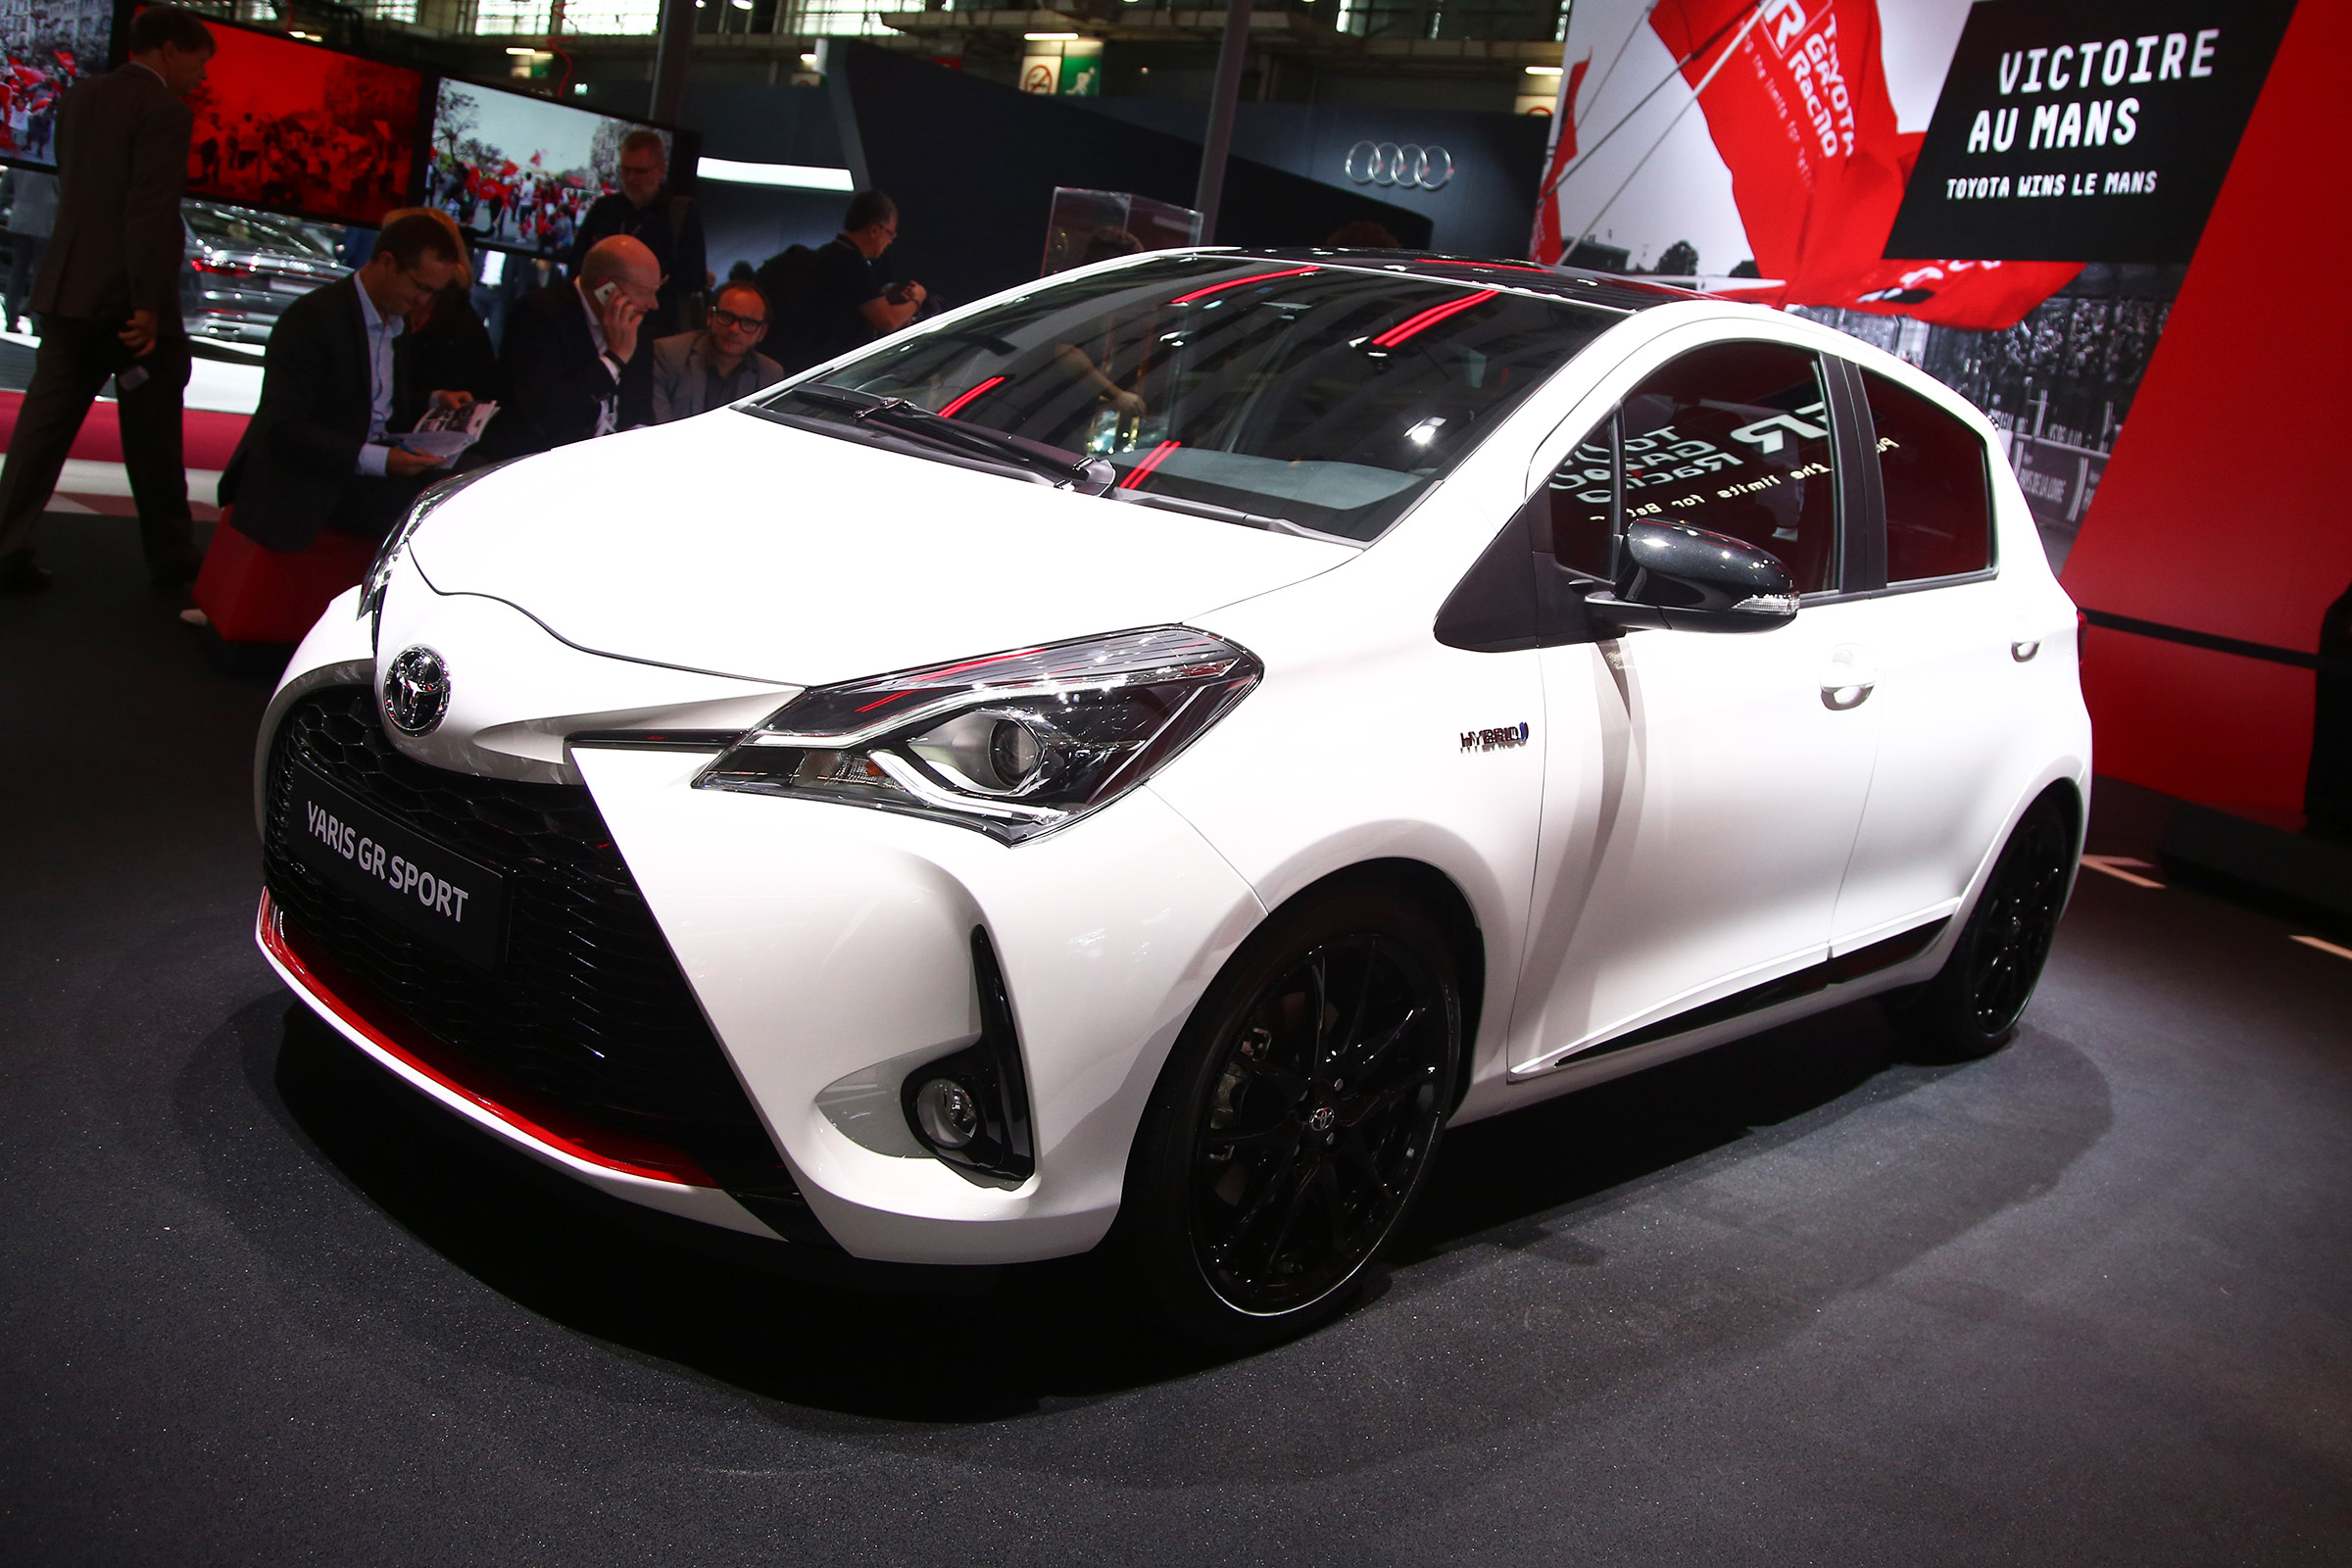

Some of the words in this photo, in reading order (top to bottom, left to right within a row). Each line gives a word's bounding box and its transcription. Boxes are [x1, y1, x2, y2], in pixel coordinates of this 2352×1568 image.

[1998, 28, 2220, 95] VICTOIRE
[1967, 109, 2019, 154] AU
[2029, 97, 2140, 150] MANS
[1946, 176, 2010, 200] TOYOTA
[2017, 173, 2066, 198] WINS
[2071, 172, 2098, 196] LE
[2103, 171, 2158, 195] MANS
[1460, 726, 1519, 748] HYBRID
[308, 801, 357, 860] YARIS
[358, 837, 386, 881] GR
[388, 856, 469, 922] SPORT
